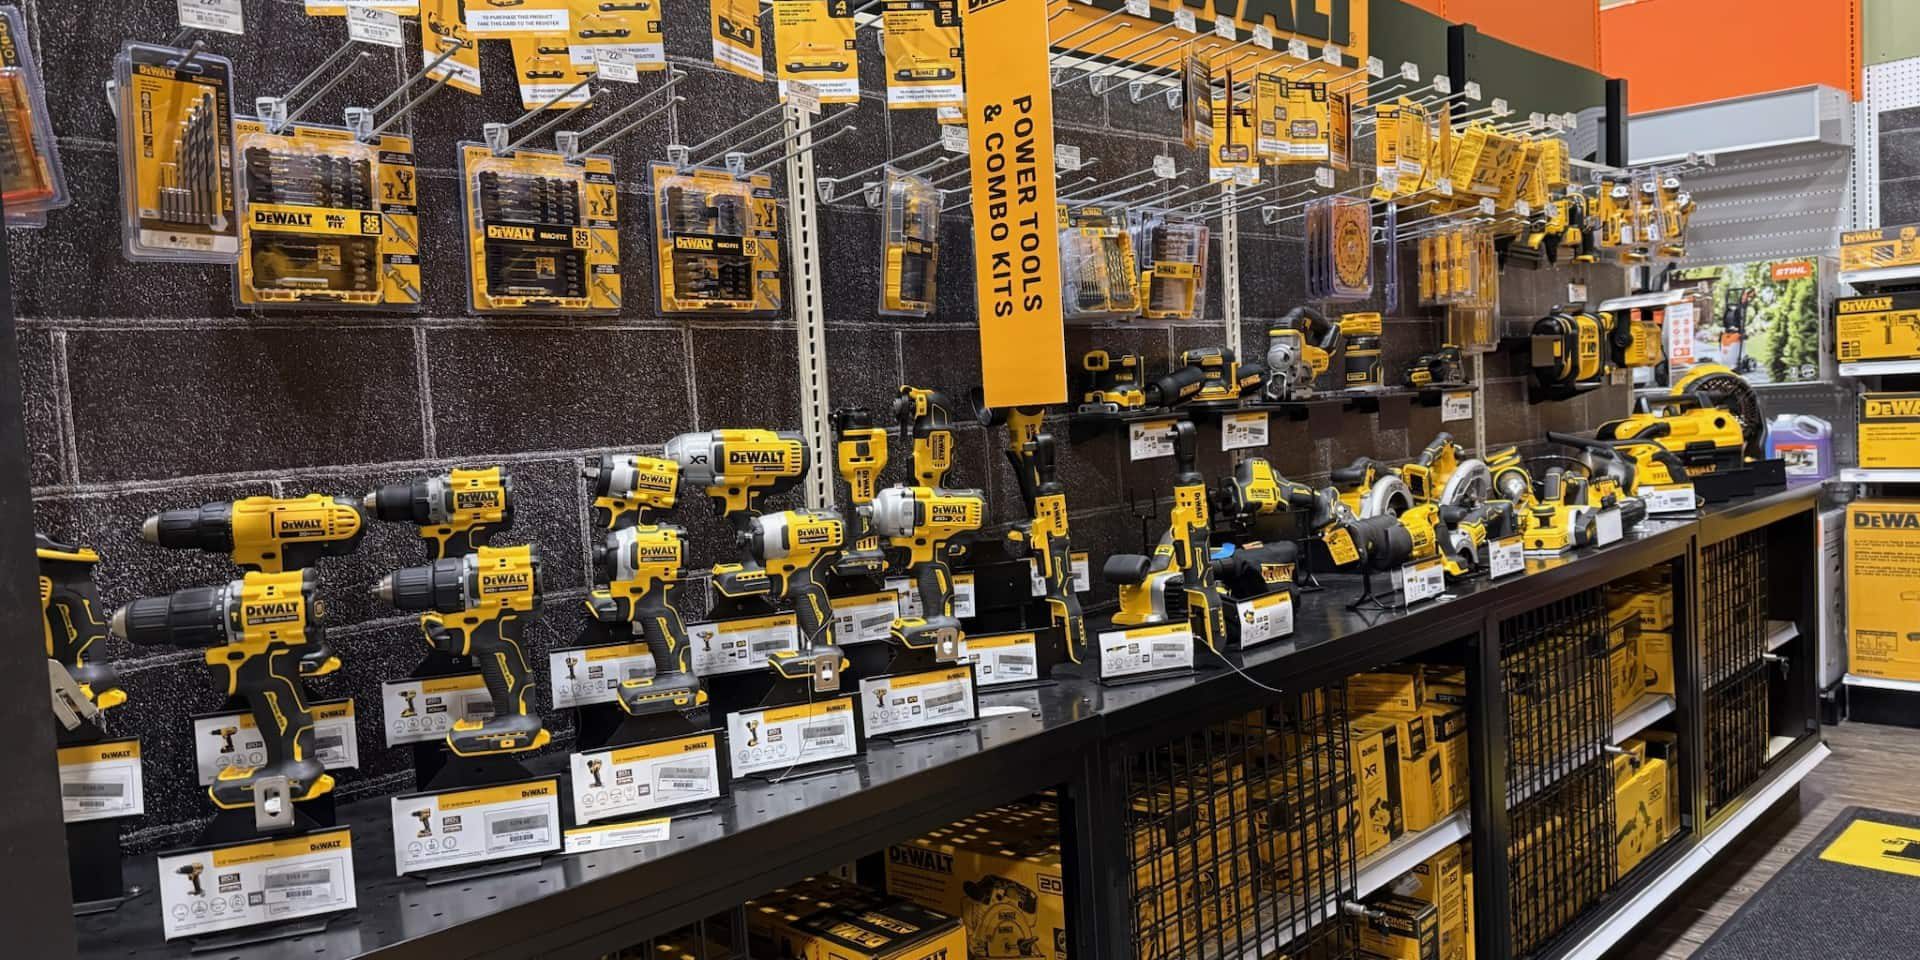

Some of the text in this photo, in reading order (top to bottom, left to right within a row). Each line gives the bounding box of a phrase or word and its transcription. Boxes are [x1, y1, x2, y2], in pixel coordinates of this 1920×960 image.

[1012, 95, 1043, 313] POWER TOOLS
[982, 103, 1014, 318] & COMBO KITS
[255, 212, 312, 226] DEWALT
[487, 225, 535, 242] DEWALT
[1842, 229, 1883, 243] DEWALT
[676, 236, 714, 250] DEWALT
[1775, 266, 1809, 277] STIHL
[1840, 297, 1893, 313] DEWALT
[690, 455, 708, 465] XR
[730, 450, 785, 464] DEWALT
[640, 473, 673, 485] DEWALT
[457, 490, 499, 502] DEWALT
[932, 505, 967, 514] DEWALT
[281, 519, 321, 529] DEWALT
[797, 527, 828, 537] DEWALT
[640, 546, 677, 556] DEWALT
[482, 573, 528, 585] DEWALT
[246, 602, 299, 616] DEWALT
[101, 750, 131, 760] DEWALT
[310, 840, 341, 852] DEWALT
[889, 845, 955, 874] DEWALT
